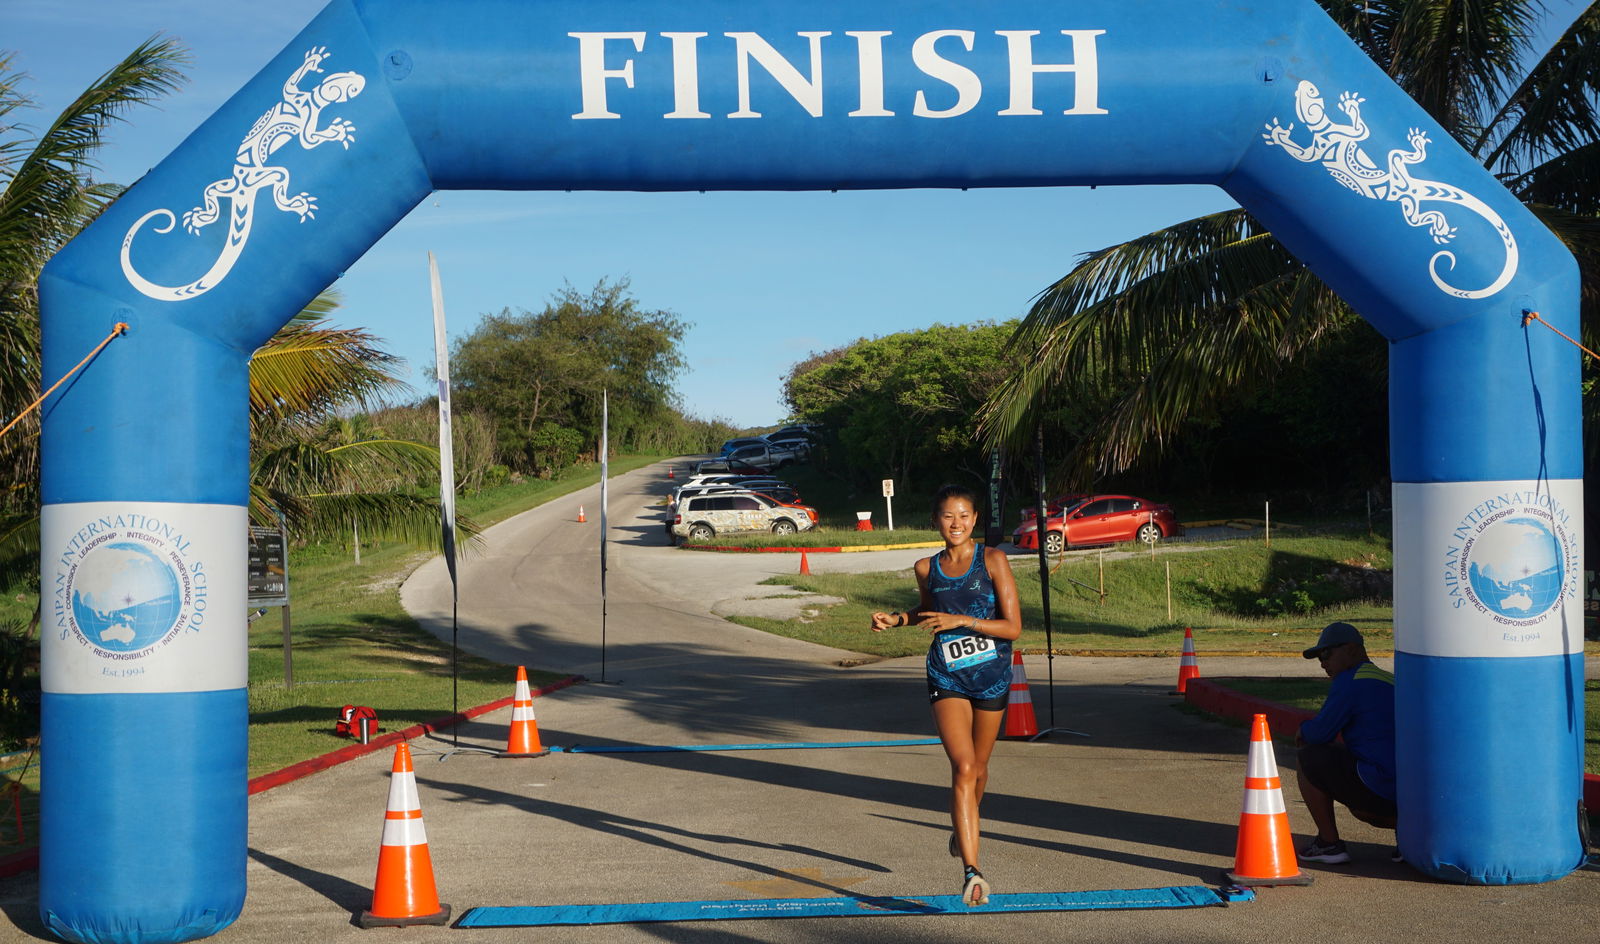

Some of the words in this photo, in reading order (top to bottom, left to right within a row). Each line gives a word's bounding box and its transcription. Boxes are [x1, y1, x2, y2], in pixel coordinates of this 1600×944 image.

[568, 29, 1109, 119] FINISH
[1453, 491, 1570, 541] INTERNATIONAL
[1476, 508, 1515, 533] LEADERSHIP
[1523, 507, 1553, 521] INTEGRITY
[61, 513, 190, 566] INTERNATIONAL
[79, 532, 117, 559] LEADERSHIP
[126, 531, 165, 548] INTEGRITY
[1556, 525, 1570, 575] PERSEVERANCE
[1445, 545, 1466, 609] SAIPAN
[1461, 537, 1475, 580] COMPASSION
[1566, 533, 1579, 601] SCHOOL
[65, 563, 78, 610] COMPASSION
[169, 551, 191, 606] PERSEVERANCE
[1552, 582, 1568, 612] INITIATIVE
[55, 572, 70, 641] SAIPAN
[185, 561, 207, 635] SCHOOL
[1464, 586, 1488, 614] RESPECT
[69, 617, 88, 647] RESPECT
[162, 615, 187, 646] INITIATIVE
[1493, 614, 1547, 627] RESPONSIBILITY
[93, 648, 154, 661] RESPONSIBILITY
[949, 636, 989, 660] 058
